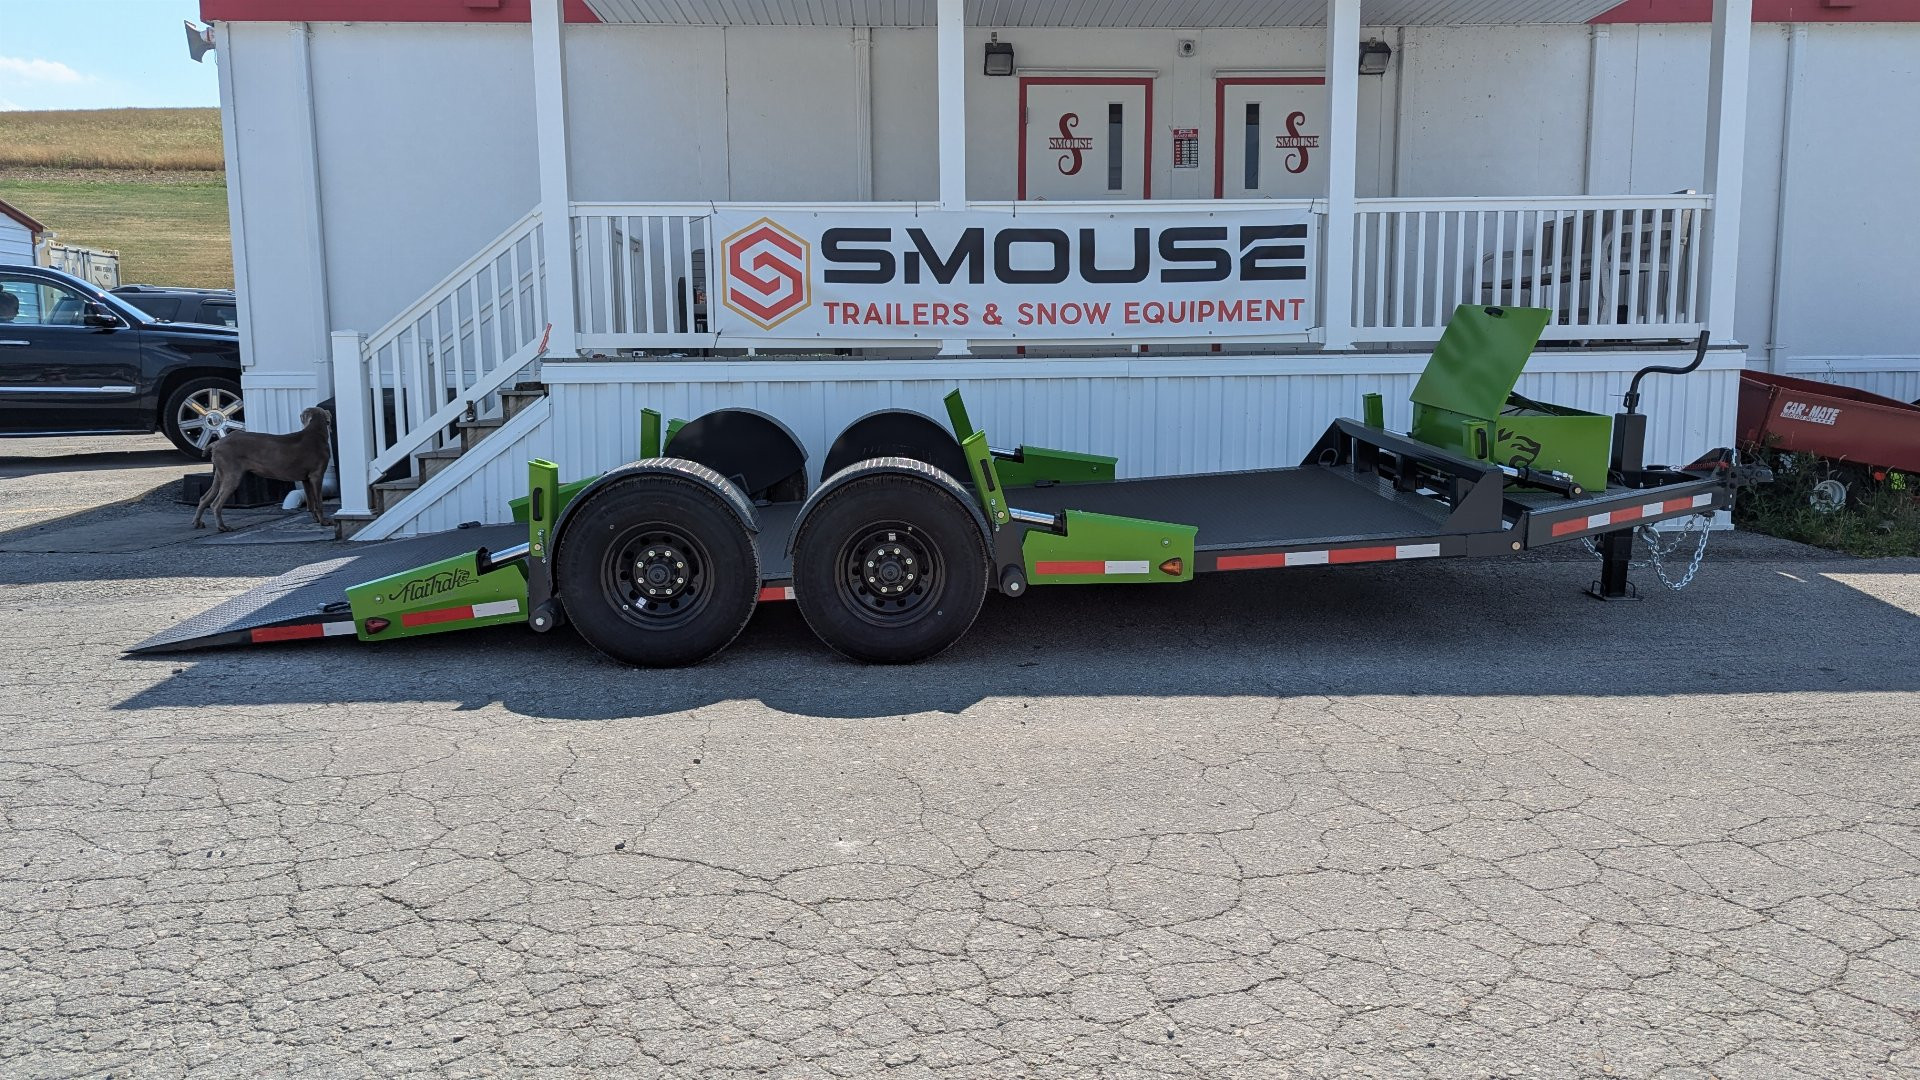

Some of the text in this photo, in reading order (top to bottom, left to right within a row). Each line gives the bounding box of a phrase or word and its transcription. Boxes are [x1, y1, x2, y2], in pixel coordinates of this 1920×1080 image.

[1049, 139, 1093, 149] SMOUSE
[1276, 137, 1319, 148] SMOUSE
[820, 223, 1308, 285] SMOUSE
[823, 298, 1306, 326] TRAILERS & SNOW EQUIPMENT
